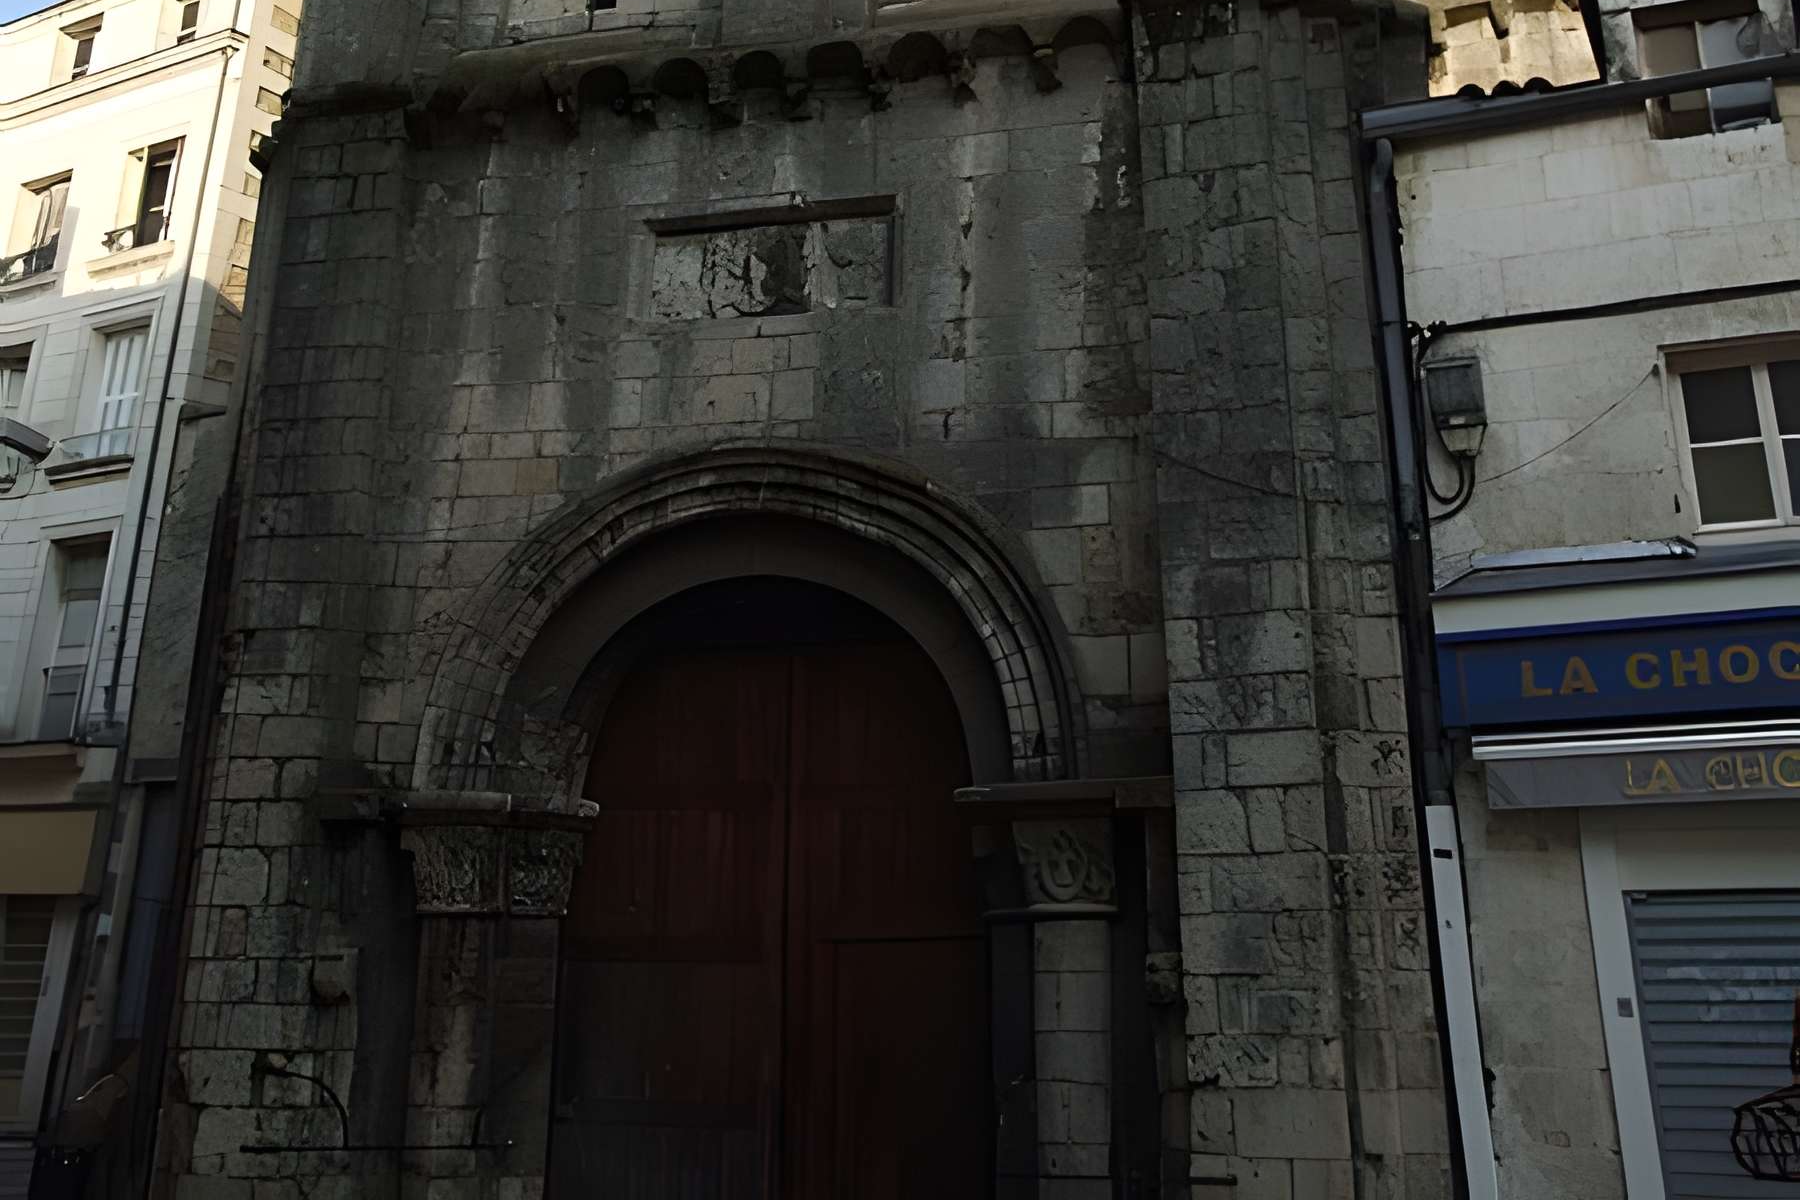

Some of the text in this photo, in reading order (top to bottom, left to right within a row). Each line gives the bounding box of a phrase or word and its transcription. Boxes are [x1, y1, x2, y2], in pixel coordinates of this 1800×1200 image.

[1520, 641, 1800, 697] LA CHOC
[1622, 758, 1682, 796] LA
